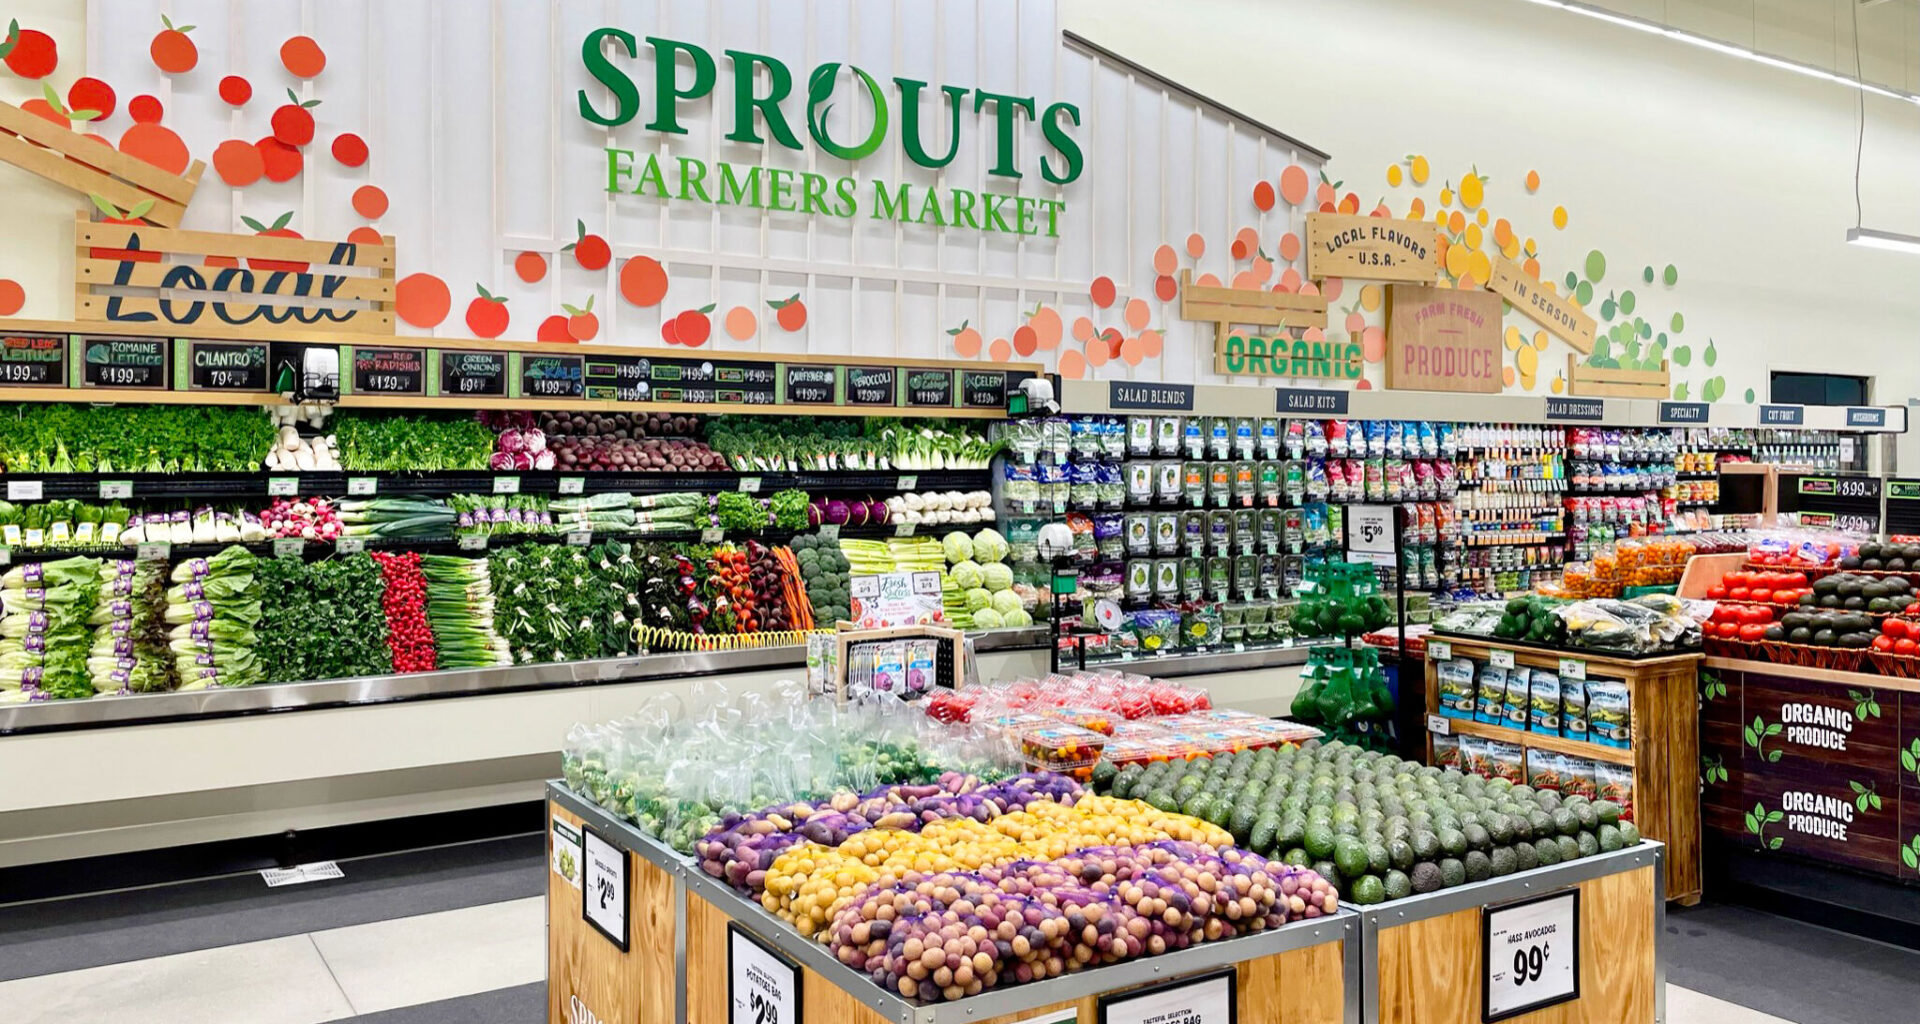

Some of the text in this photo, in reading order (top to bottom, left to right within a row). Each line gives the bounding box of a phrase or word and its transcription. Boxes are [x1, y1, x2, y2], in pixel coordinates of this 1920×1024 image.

[578, 27, 1084, 184] SPROUTS
[604, 148, 1066, 238] FARMERS MARKET
[1326, 227, 1426, 260] LOCAL FLAVORS
[106, 232, 359, 325] Local
[1415, 302, 1484, 328] FARM FRESH
[1513, 280, 1577, 332] IN SEASON
[110, 353, 162, 365] LETTUCE
[111, 342, 156, 353] ROMAINE
[195, 350, 250, 367] CILANTRO
[463, 355, 493, 363] GREEN
[1227, 336, 1362, 379] ORGANIC
[462, 363, 501, 372] ONIONS
[1404, 344, 1493, 378] PRODUCE
[855, 371, 890, 387] BROCCOLI
[974, 375, 1003, 387] CELERY
[1118, 388, 1185, 405] SALAD BLENDS
[1288, 395, 1336, 409] SALAD KITS
[1547, 402, 1603, 416] SALAD DRESSINGS
[1670, 407, 1700, 419] SPECIALTY
[1768, 410, 1794, 421] CUT FRUIT
[1781, 703, 1853, 732] ORGANIC
[1787, 726, 1847, 751] PRODUCE
[1782, 791, 1854, 823] ORGANIC
[1788, 815, 1848, 841] PRODUCE
[1507, 933, 1523, 944] HASS
[1524, 924, 1557, 940] AVOCADOS
[1513, 940, 1550, 986] 99¢
[746, 968, 782, 1002] POTATOES BAG
